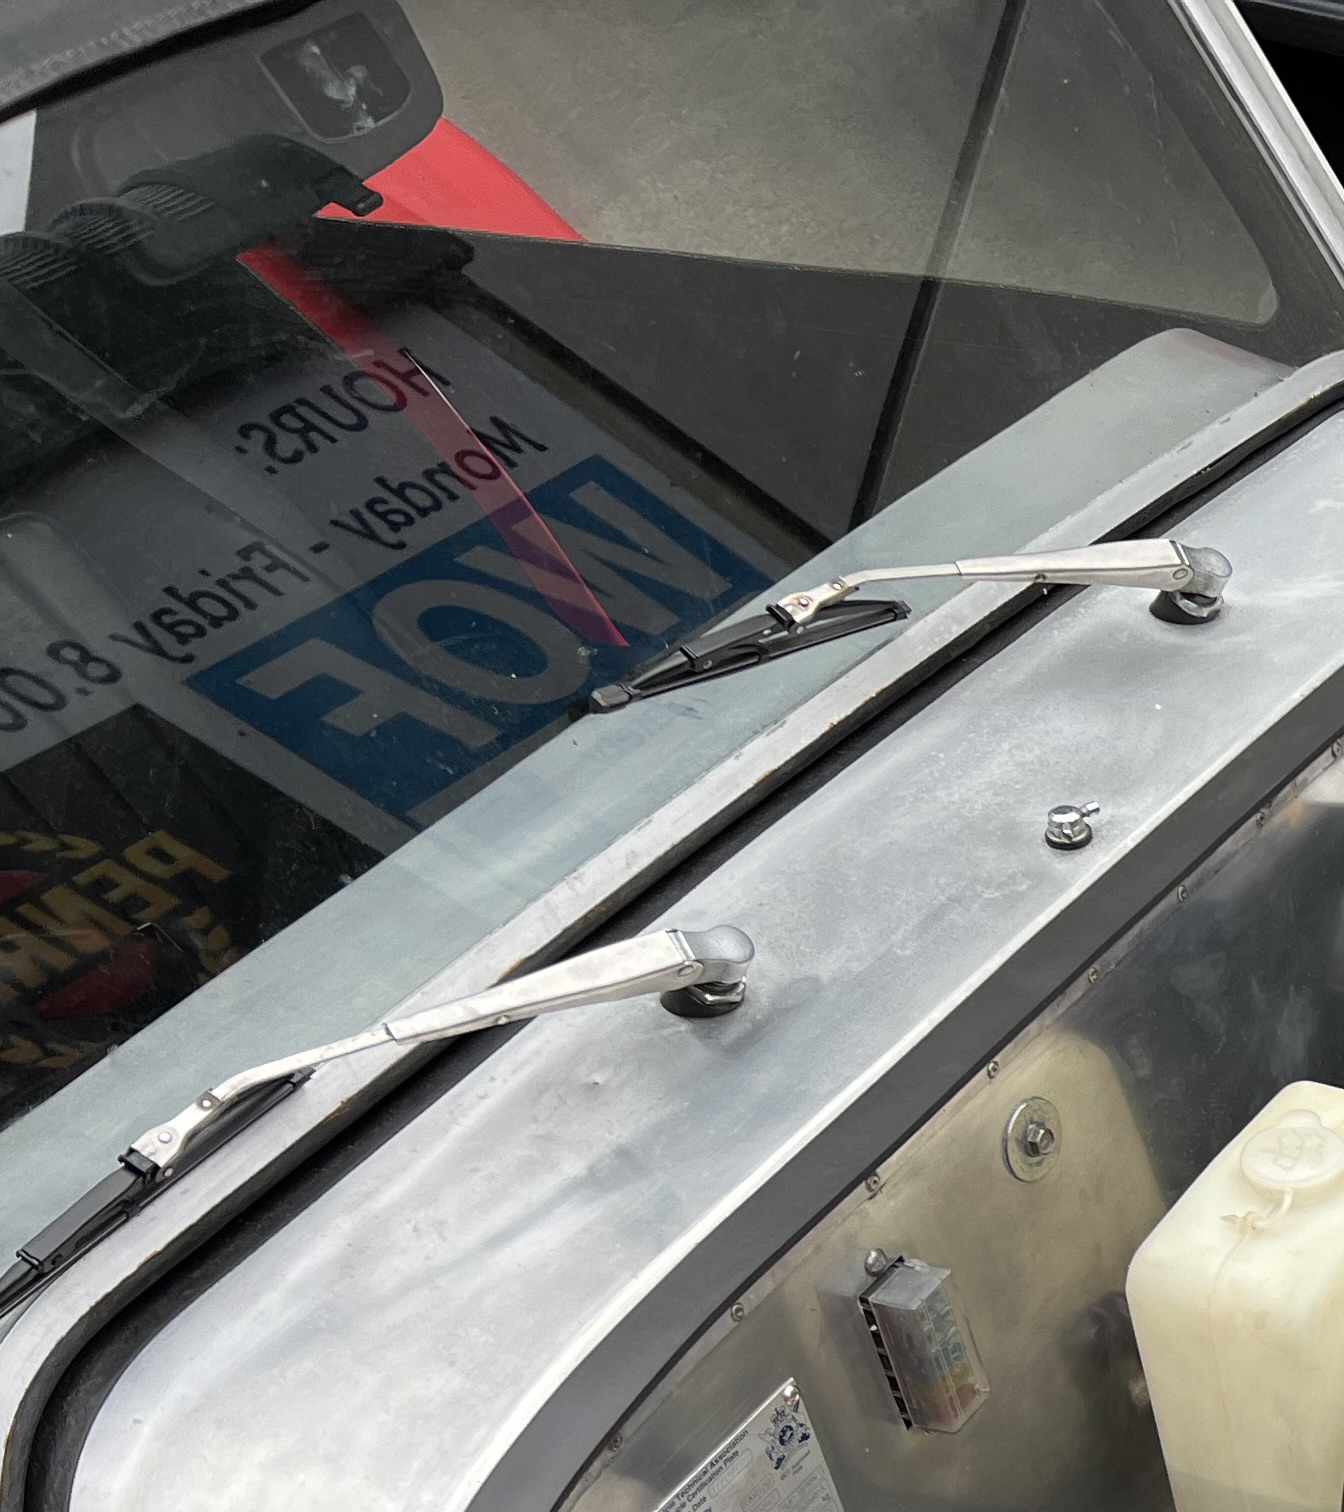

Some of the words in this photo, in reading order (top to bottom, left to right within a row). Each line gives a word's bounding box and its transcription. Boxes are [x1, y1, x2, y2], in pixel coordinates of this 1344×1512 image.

[676, 1467, 708, 1500] Technical
[709, 1428, 748, 1468] Association
[687, 1464, 723, 1502] Certification
